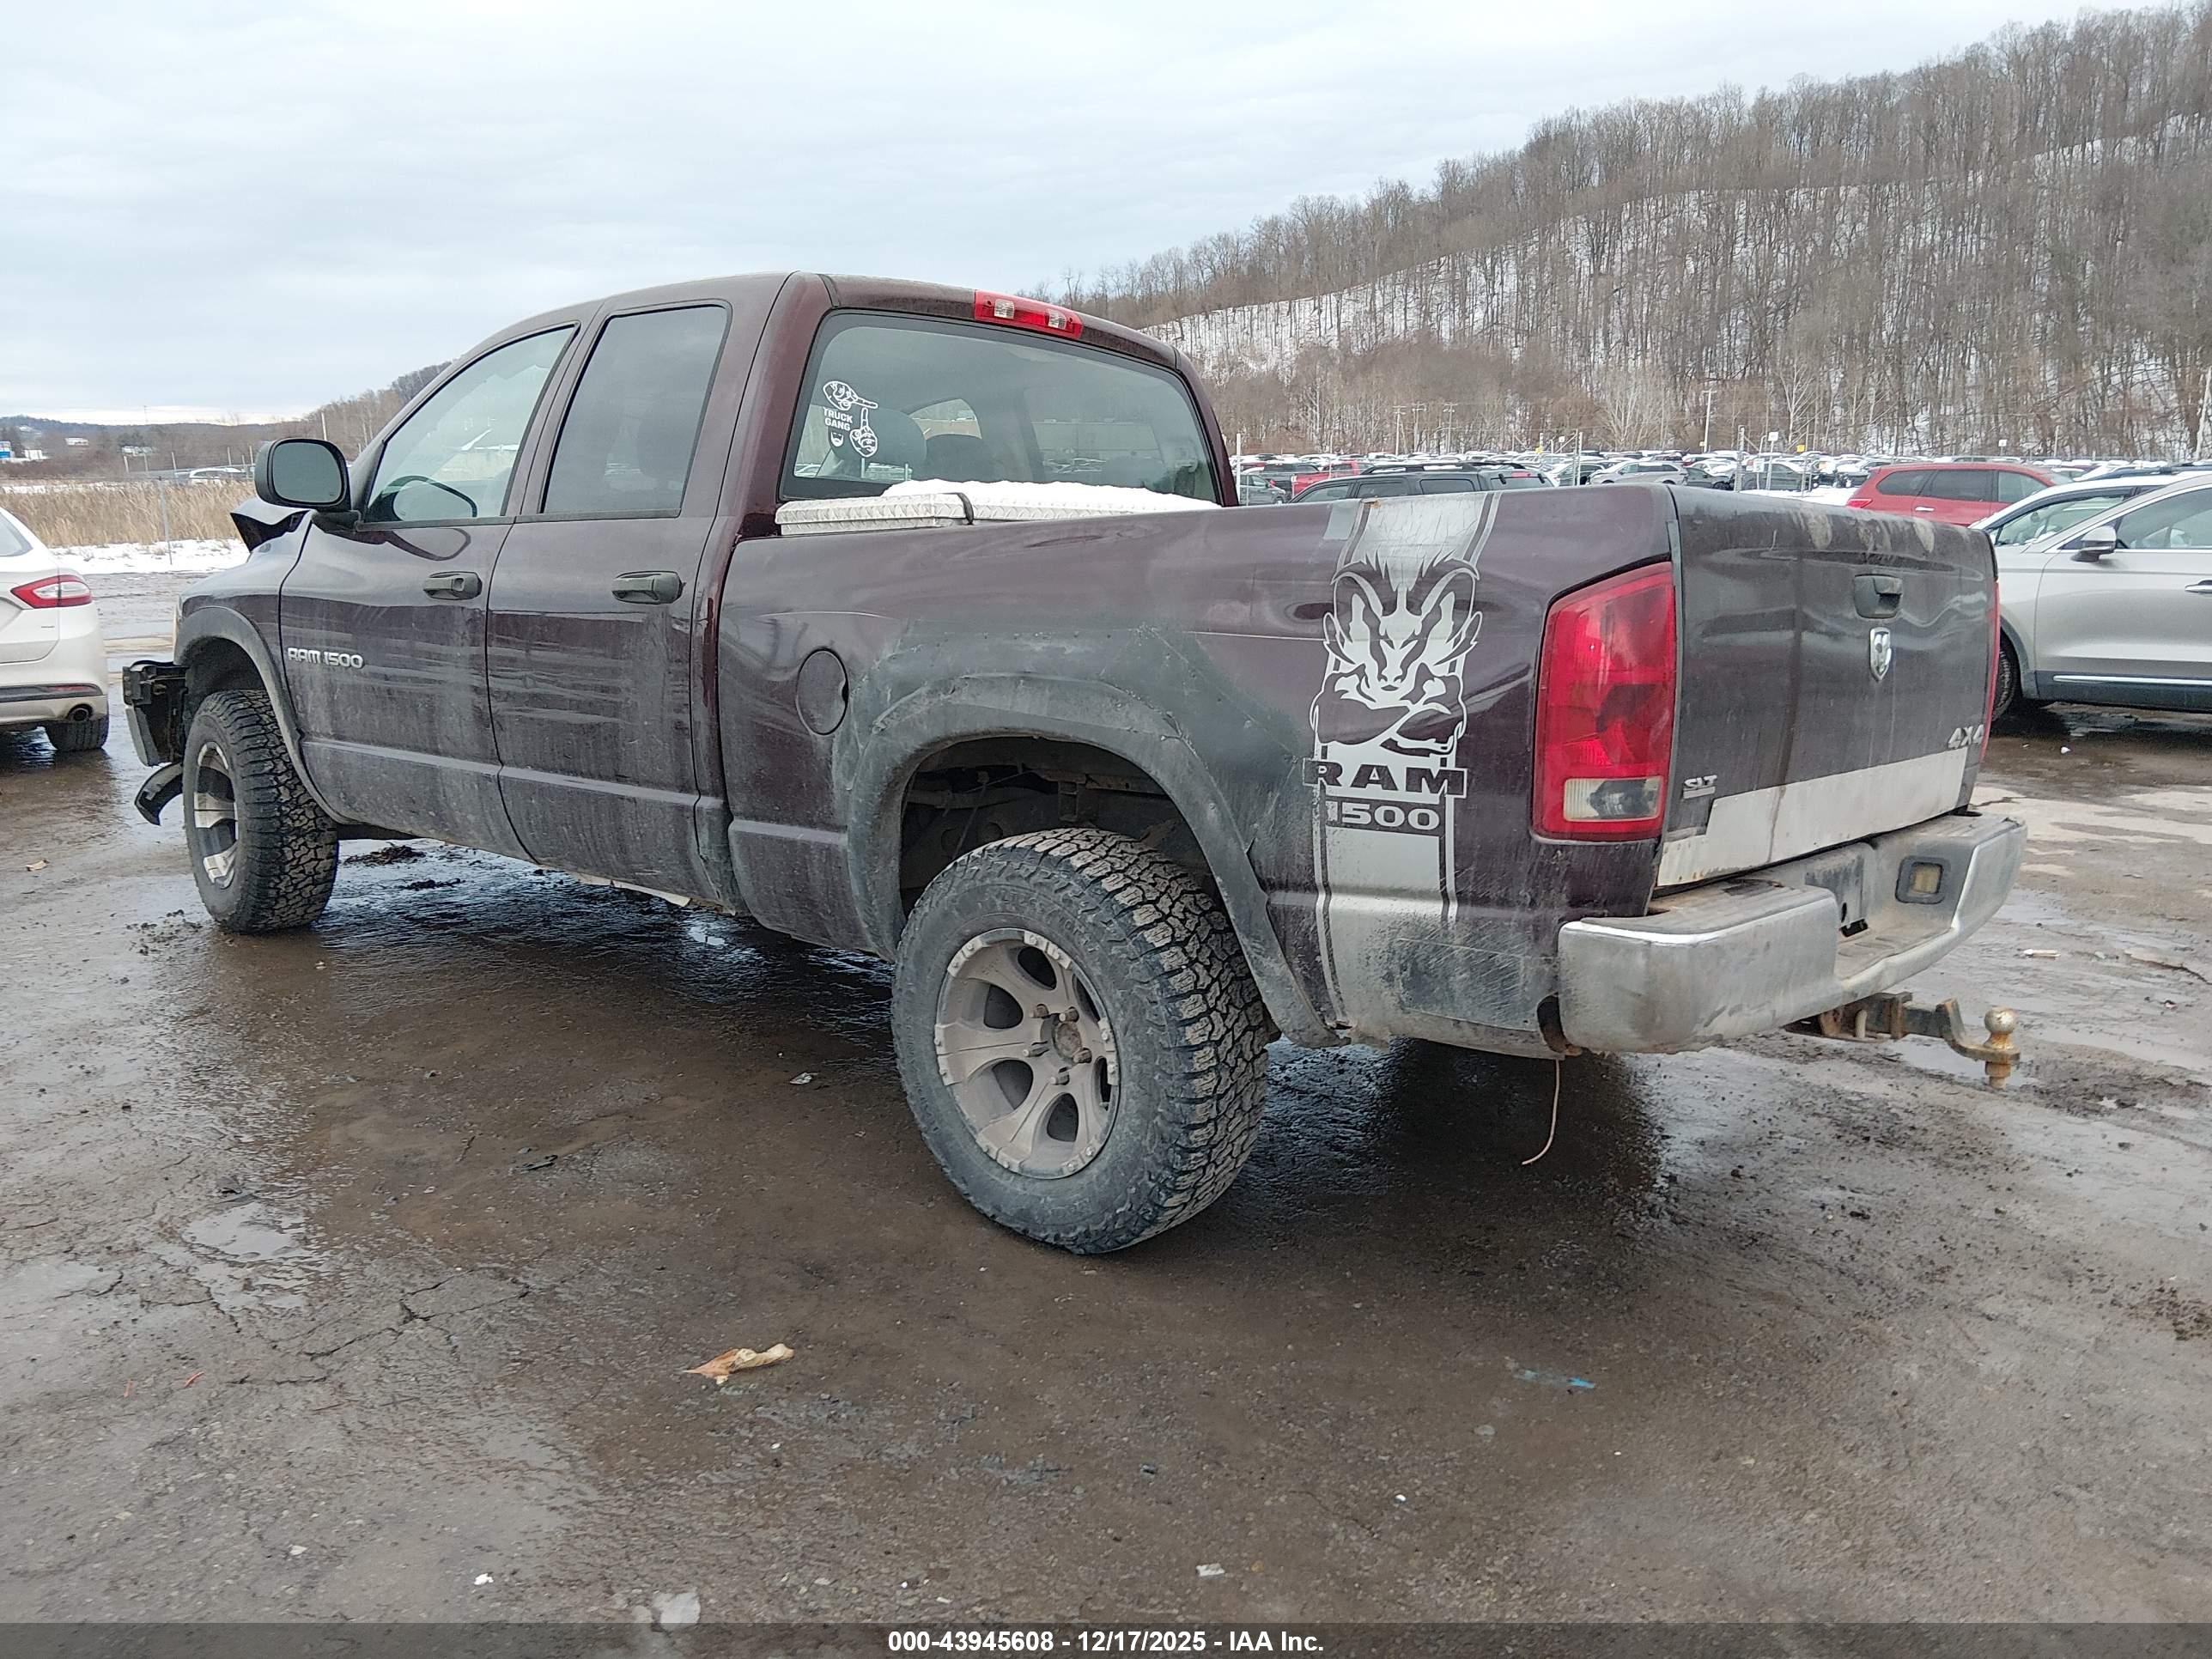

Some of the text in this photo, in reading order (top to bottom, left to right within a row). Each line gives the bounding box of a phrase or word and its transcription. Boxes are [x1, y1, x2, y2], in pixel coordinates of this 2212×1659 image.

[823, 406, 854, 424] TRUCK
[824, 417, 852, 431] GANG
[287, 647, 364, 669] RAM 1500
[1304, 760, 1466, 797] RAM
[1325, 799, 1441, 831] 1500
